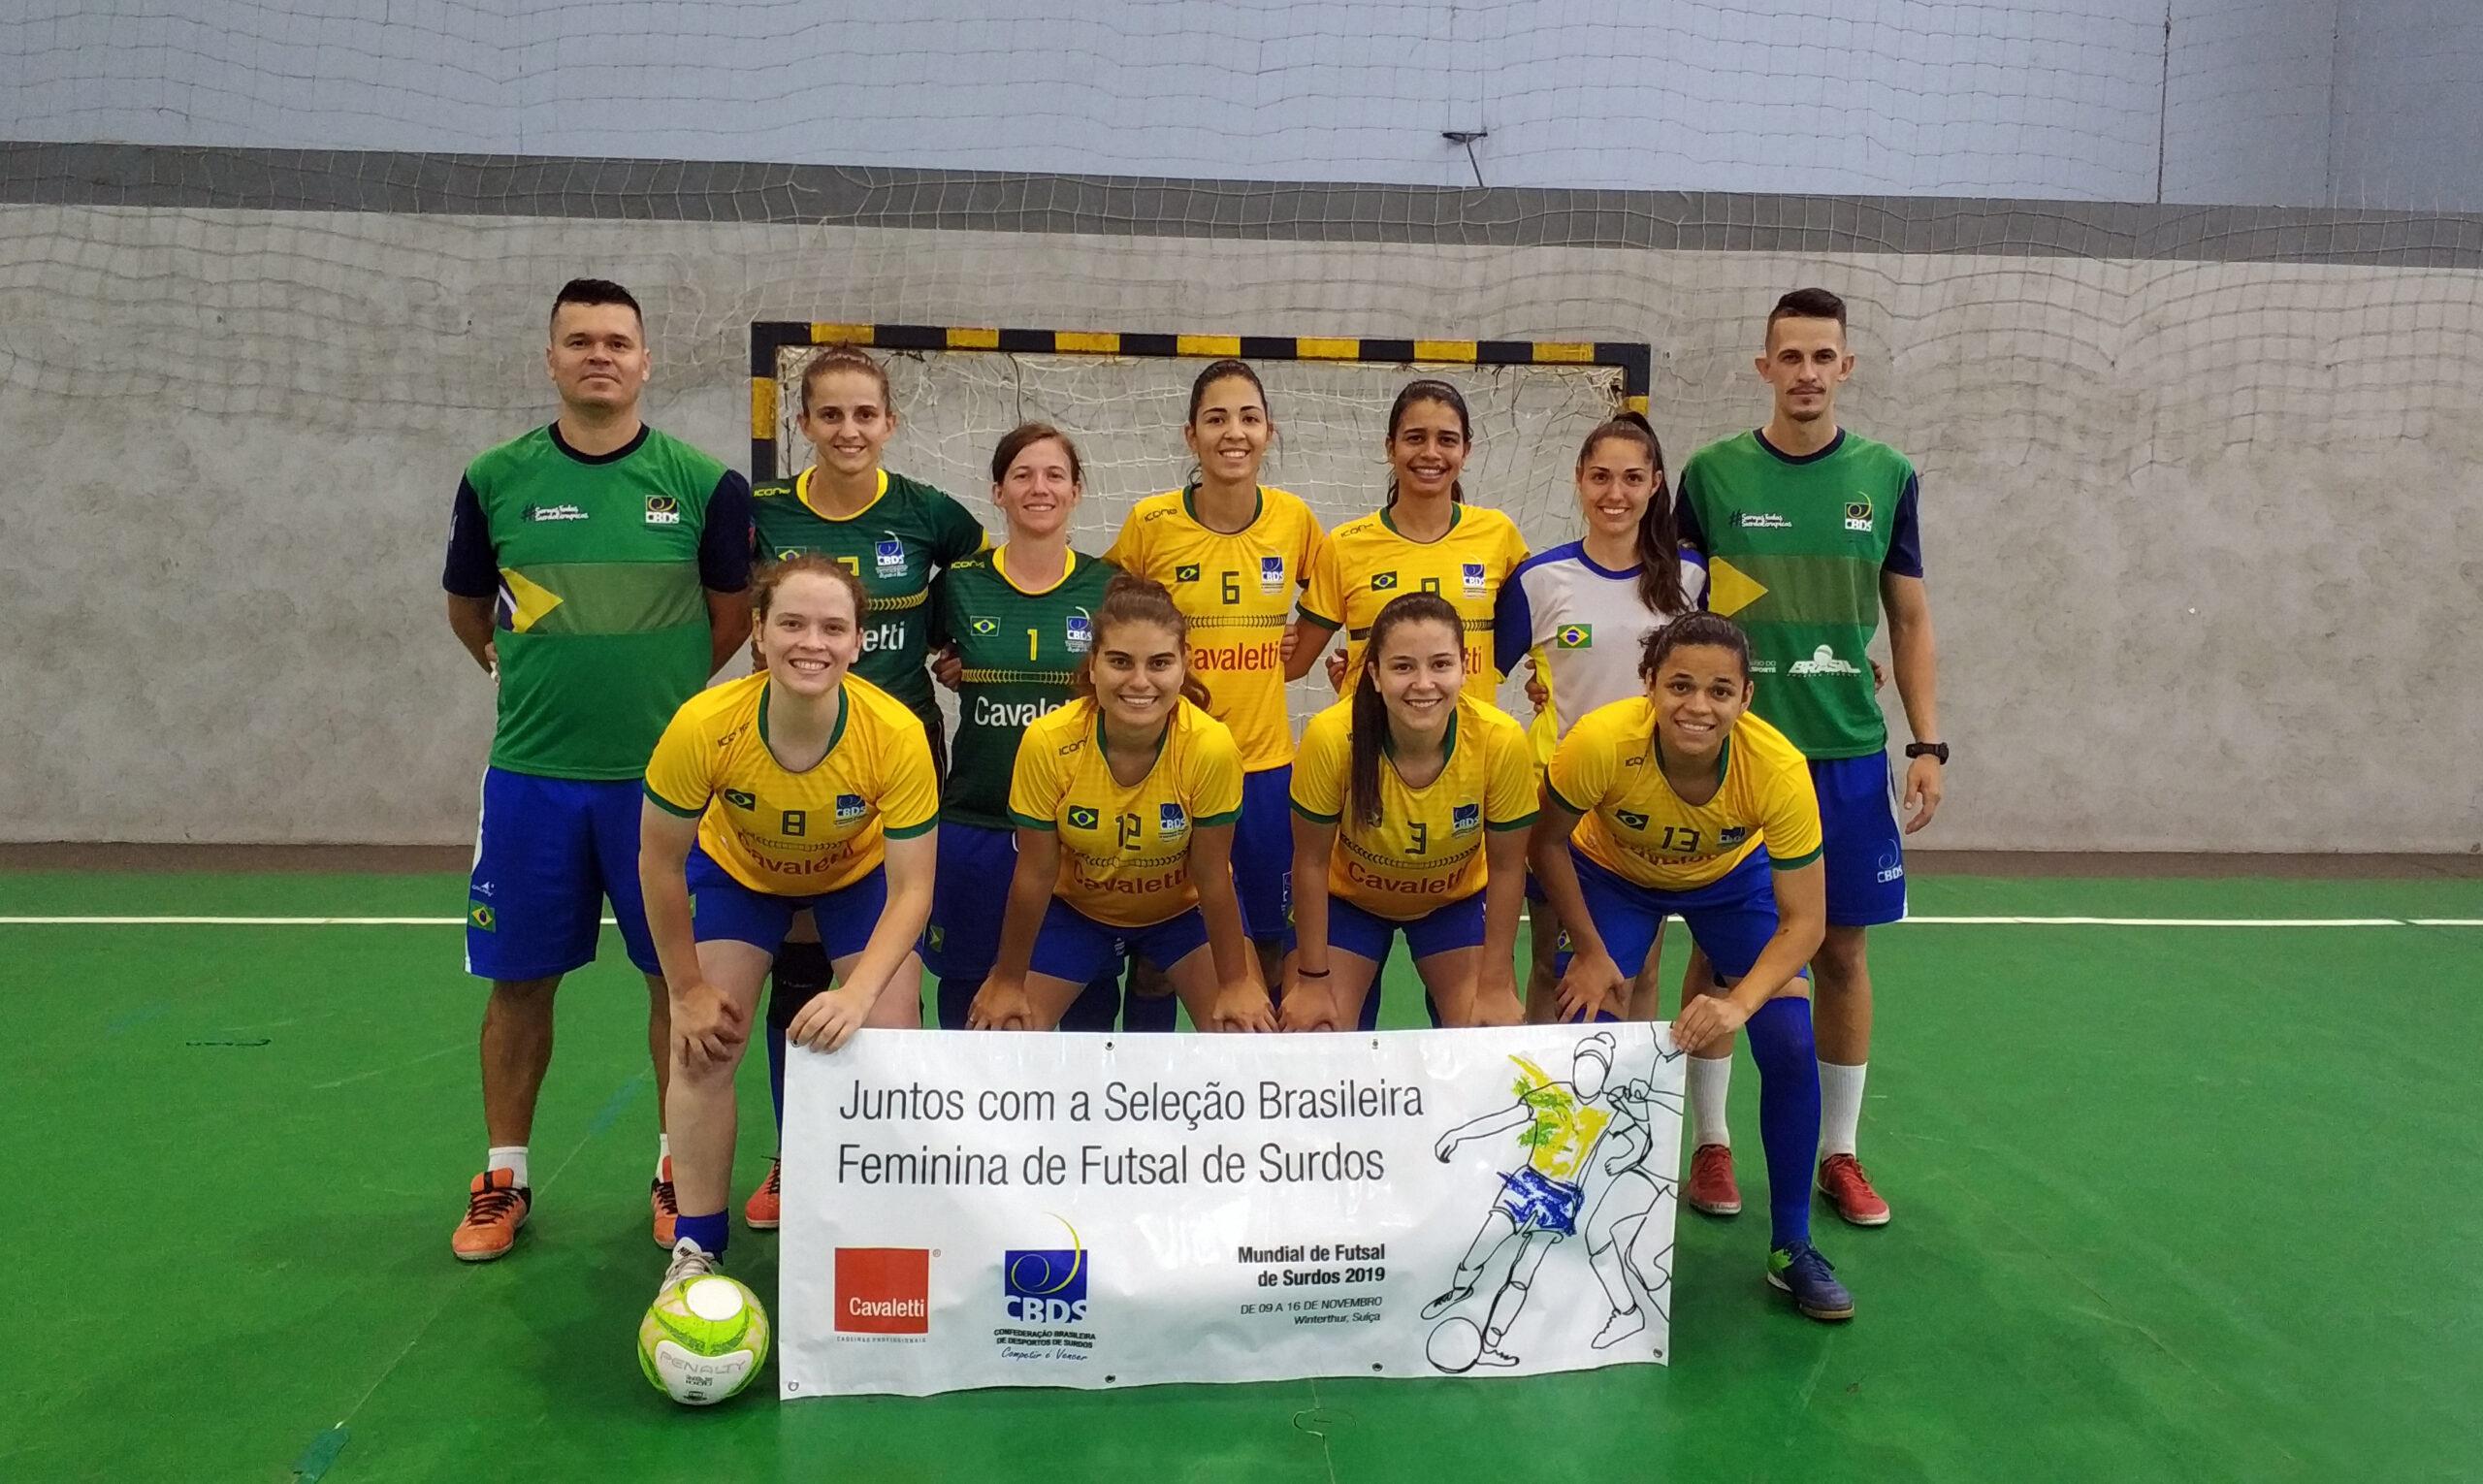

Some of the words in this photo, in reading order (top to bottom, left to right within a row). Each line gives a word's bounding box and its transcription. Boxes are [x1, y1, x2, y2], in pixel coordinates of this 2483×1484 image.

[645, 511, 680, 524] CBDS
[1845, 518, 1873, 532] CBDS
[877, 554, 905, 565] CBDS
[1222, 571, 1240, 604] 6
[1027, 629, 1038, 661] 1
[1067, 629, 1093, 641] CBDS
[836, 806, 867, 819] CBDS
[782, 810, 806, 837] 8
[1115, 813, 1141, 850] 12
[1160, 818, 1187, 830] CBDS
[1404, 821, 1427, 855] 3
[1661, 826, 1700, 853] 13
[1877, 863, 1904, 884] CBDS
[839, 1079, 965, 1121] Juntos
[978, 1089, 1055, 1122] com
[1070, 1090, 1091, 1122] a
[1104, 1081, 1245, 1131] Seleção
[1258, 1078, 1425, 1120] Brasileira
[838, 1143, 1009, 1185] Feminina
[1022, 1145, 1067, 1186] de
[1081, 1144, 1187, 1185] Futsal
[1202, 1144, 1245, 1184] de
[1259, 1142, 1385, 1183] Surdos
[1238, 1244, 1306, 1264] Mundial
[1309, 1244, 1331, 1262] de
[1335, 1242, 1386, 1261] Futsal
[1257, 1270, 1278, 1287] de
[1282, 1268, 1340, 1287] Surdos
[1344, 1266, 1386, 1284] 2019
[849, 1297, 925, 1318] Cavaletti
[1003, 1294, 1088, 1323] CBDS
[1241, 1304, 1256, 1315] DE
[1258, 1303, 1274, 1314] 09
[1274, 1302, 1284, 1312] A
[1287, 1301, 1302, 1311] 16
[1304, 1300, 1319, 1310] DE
[1321, 1296, 1383, 1309] NOVEMBRO
[1294, 1313, 1350, 1325] Winterthur,
[1008, 1338, 1051, 1346] DESPORTOS
[1063, 1339, 1094, 1349] SURDOS
[1053, 1330, 1097, 1340] BRASILEIRA
[660, 1350, 746, 1375] PENALTY
